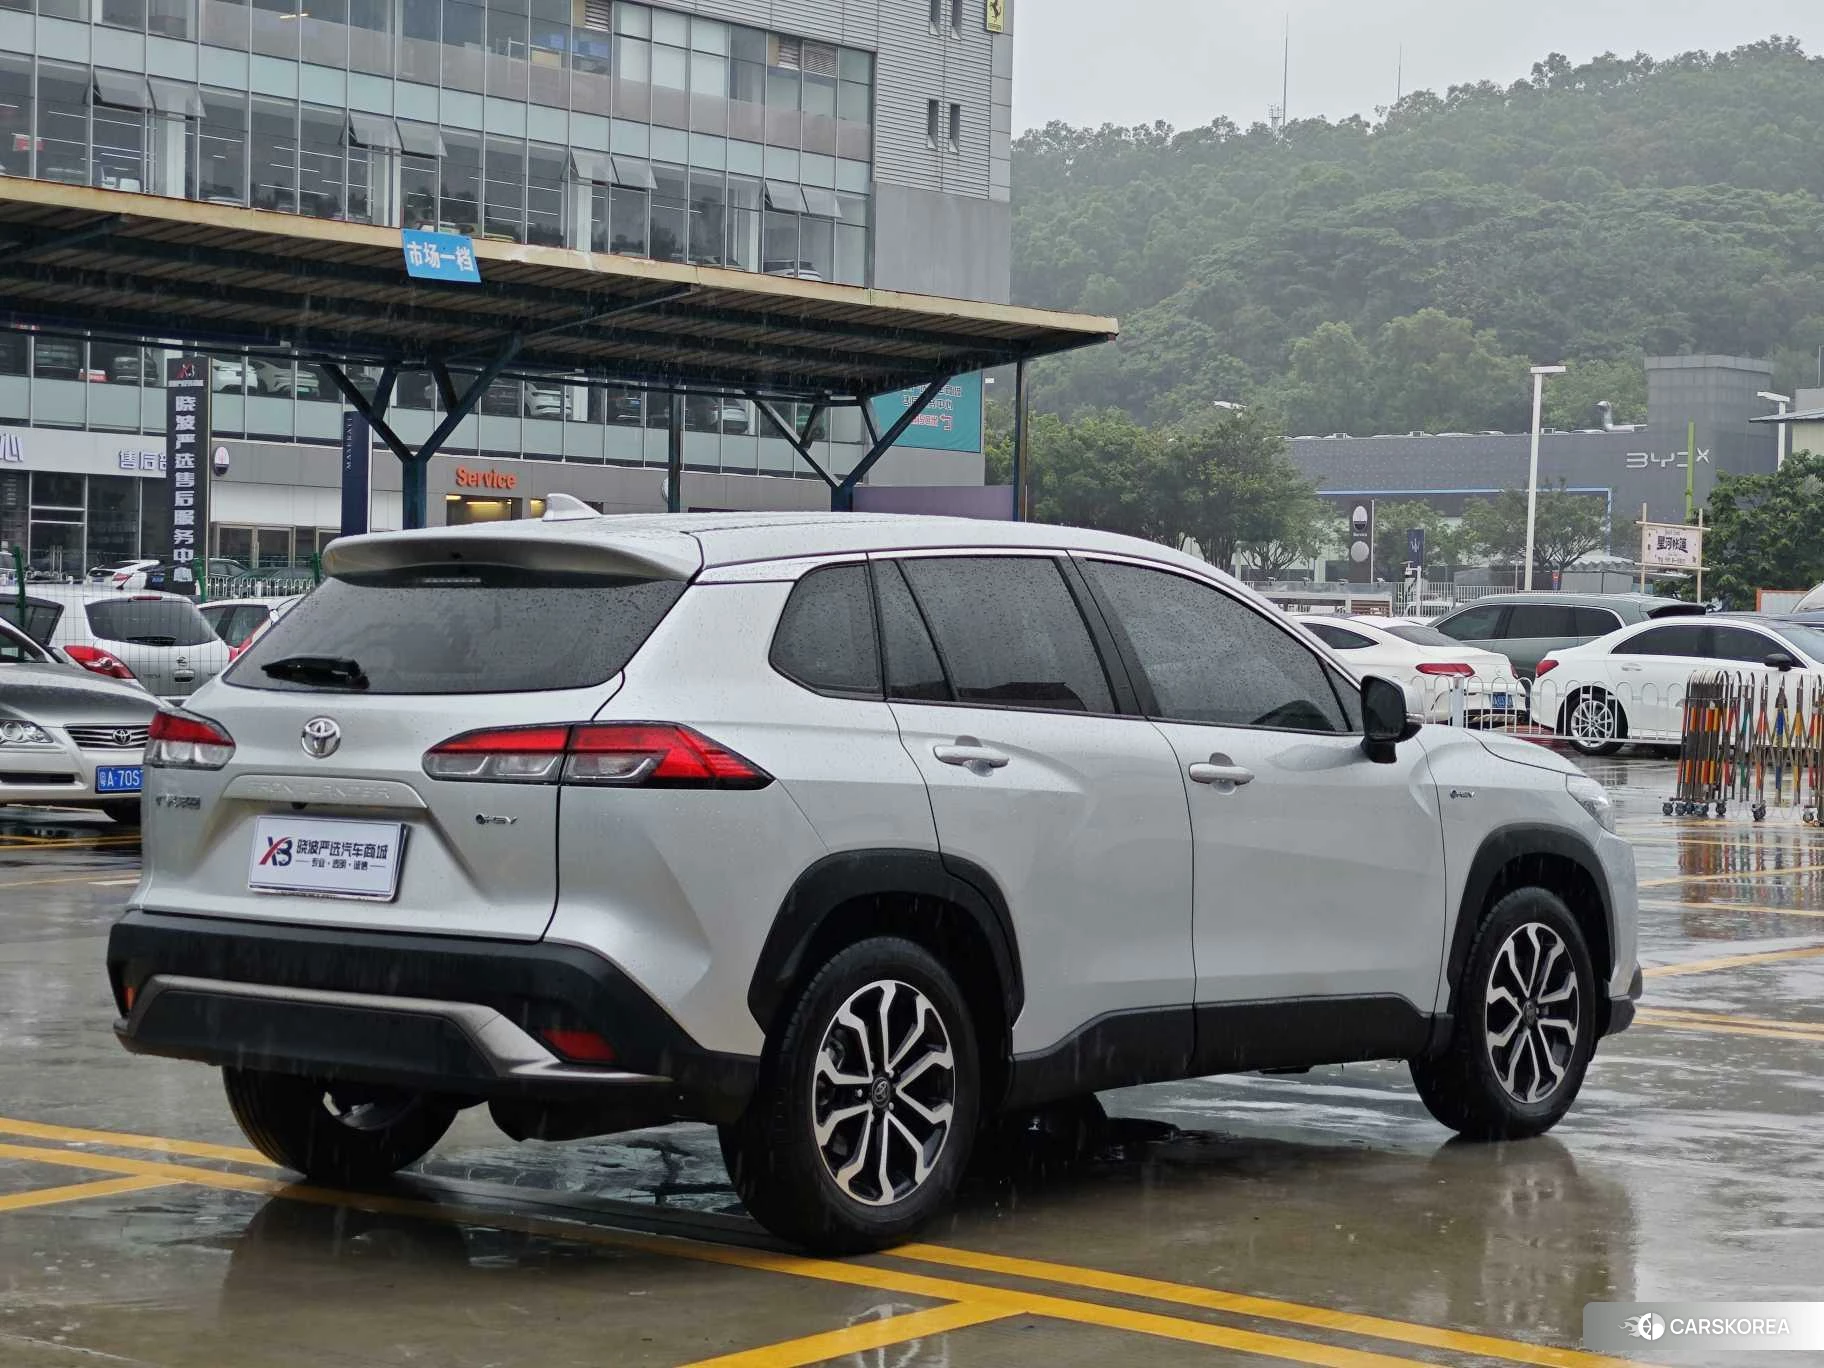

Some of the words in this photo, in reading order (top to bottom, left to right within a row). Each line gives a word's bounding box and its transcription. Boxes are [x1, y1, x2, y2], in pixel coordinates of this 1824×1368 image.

[406, 241, 474, 272] 市场一档
[456, 465, 517, 489] Service
